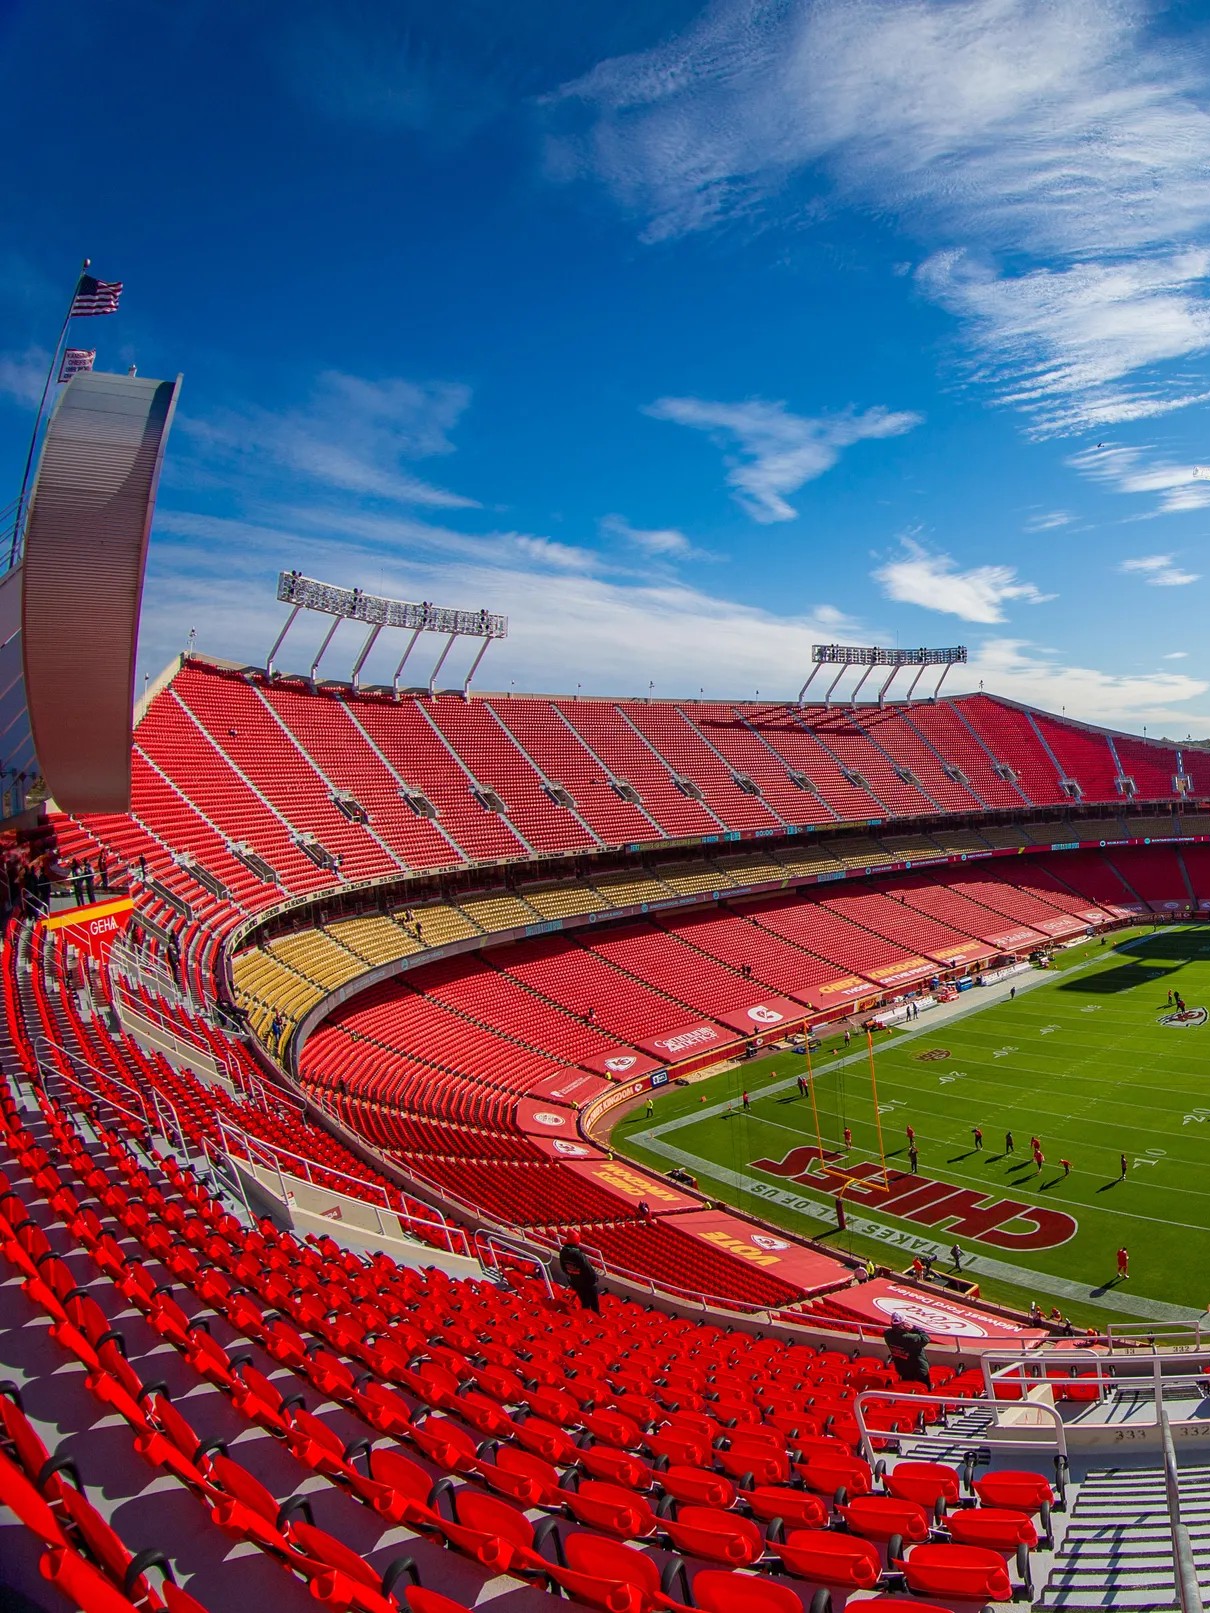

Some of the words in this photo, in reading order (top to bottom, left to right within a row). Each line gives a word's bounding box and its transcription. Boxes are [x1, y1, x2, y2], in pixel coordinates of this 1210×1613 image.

[387, 874, 405, 882] CHERRY
[90, 915, 119, 936] GEHA
[932, 943, 981, 959] HONORS
[868, 957, 928, 979] KINGDOM
[880, 976, 893, 984] ON
[906, 963, 938, 978] FRONT
[819, 976, 863, 994] CHIEFS
[841, 982, 875, 995] THOSE
[654, 1026, 714, 1048] Community
[939, 1071, 967, 1082] 20
[603, 1086, 634, 1107] KINGDOM
[1137, 1148, 1167, 1166] 10
[592, 1171, 647, 1197] CHIEFS
[600, 1164, 682, 1201] KINGDOM
[751, 1184, 781, 1198] US
[745, 1146, 1079, 1252] CHIEFS
[781, 1197, 810, 1209] OF
[697, 1231, 782, 1267] VOTE
[862, 1224, 939, 1255] TAKES
[886, 1284, 935, 1304] Dealers
[892, 1304, 968, 1330] Ford
[933, 1301, 965, 1315] Ford
[964, 1311, 1023, 1333] Midwest
[1114, 1429, 1146, 1442] 333
[1180, 1425, 1210, 1437] 332
